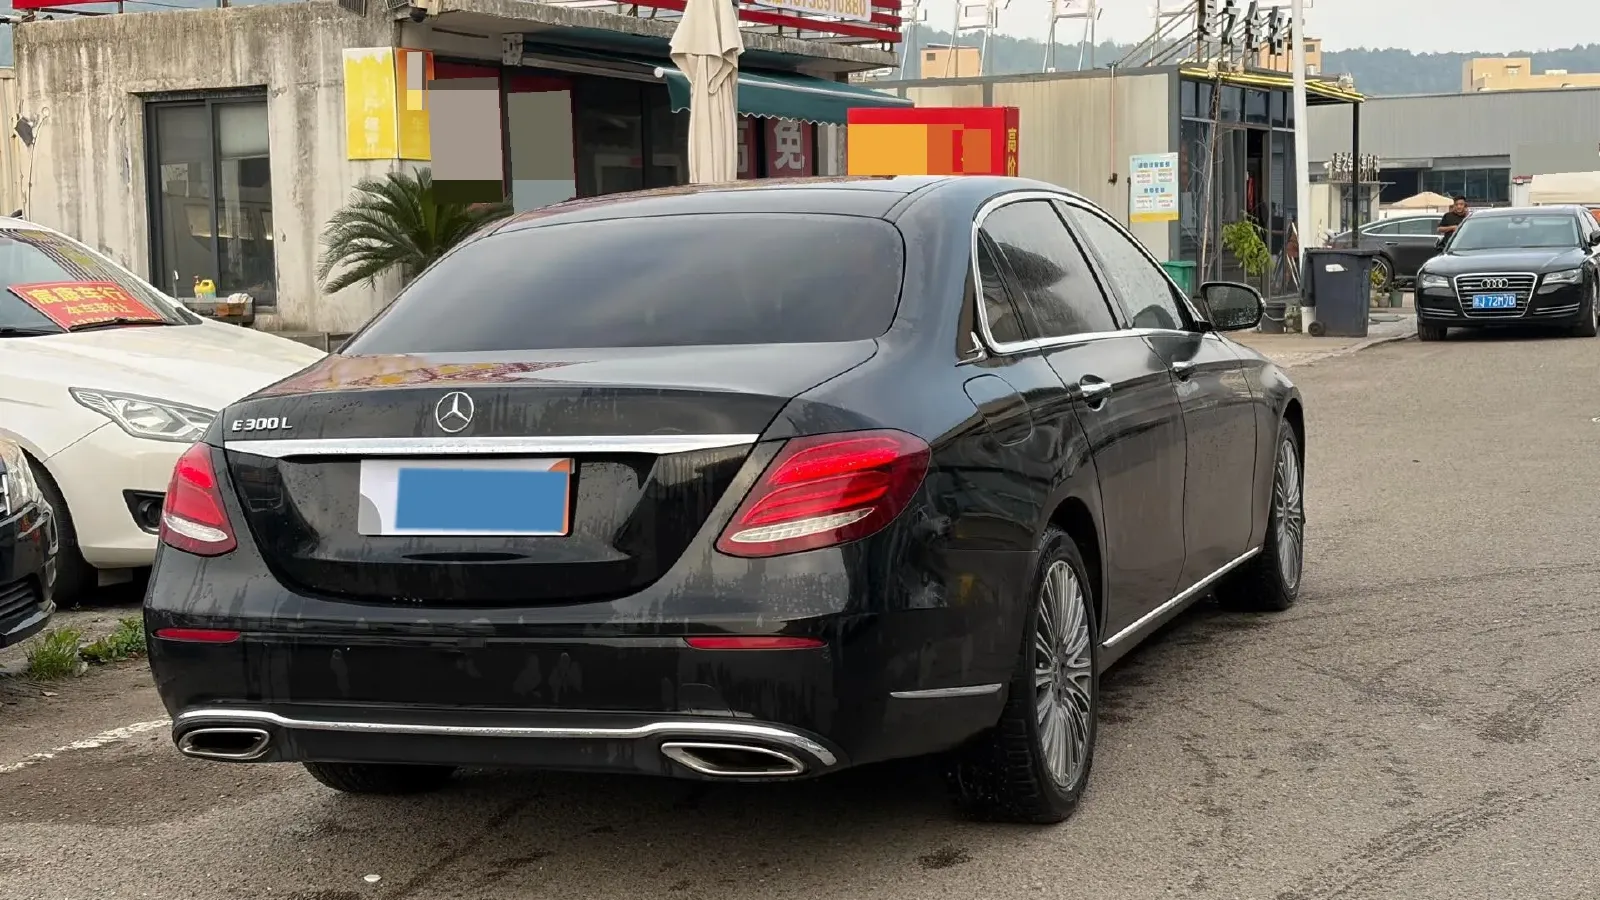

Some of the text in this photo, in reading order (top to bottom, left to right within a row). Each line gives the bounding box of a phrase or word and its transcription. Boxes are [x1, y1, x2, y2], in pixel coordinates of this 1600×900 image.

[773, 119, 805, 170] 免
[1007, 127, 1017, 177] 高价
[1333, 152, 1380, 173] 星之会车广场
